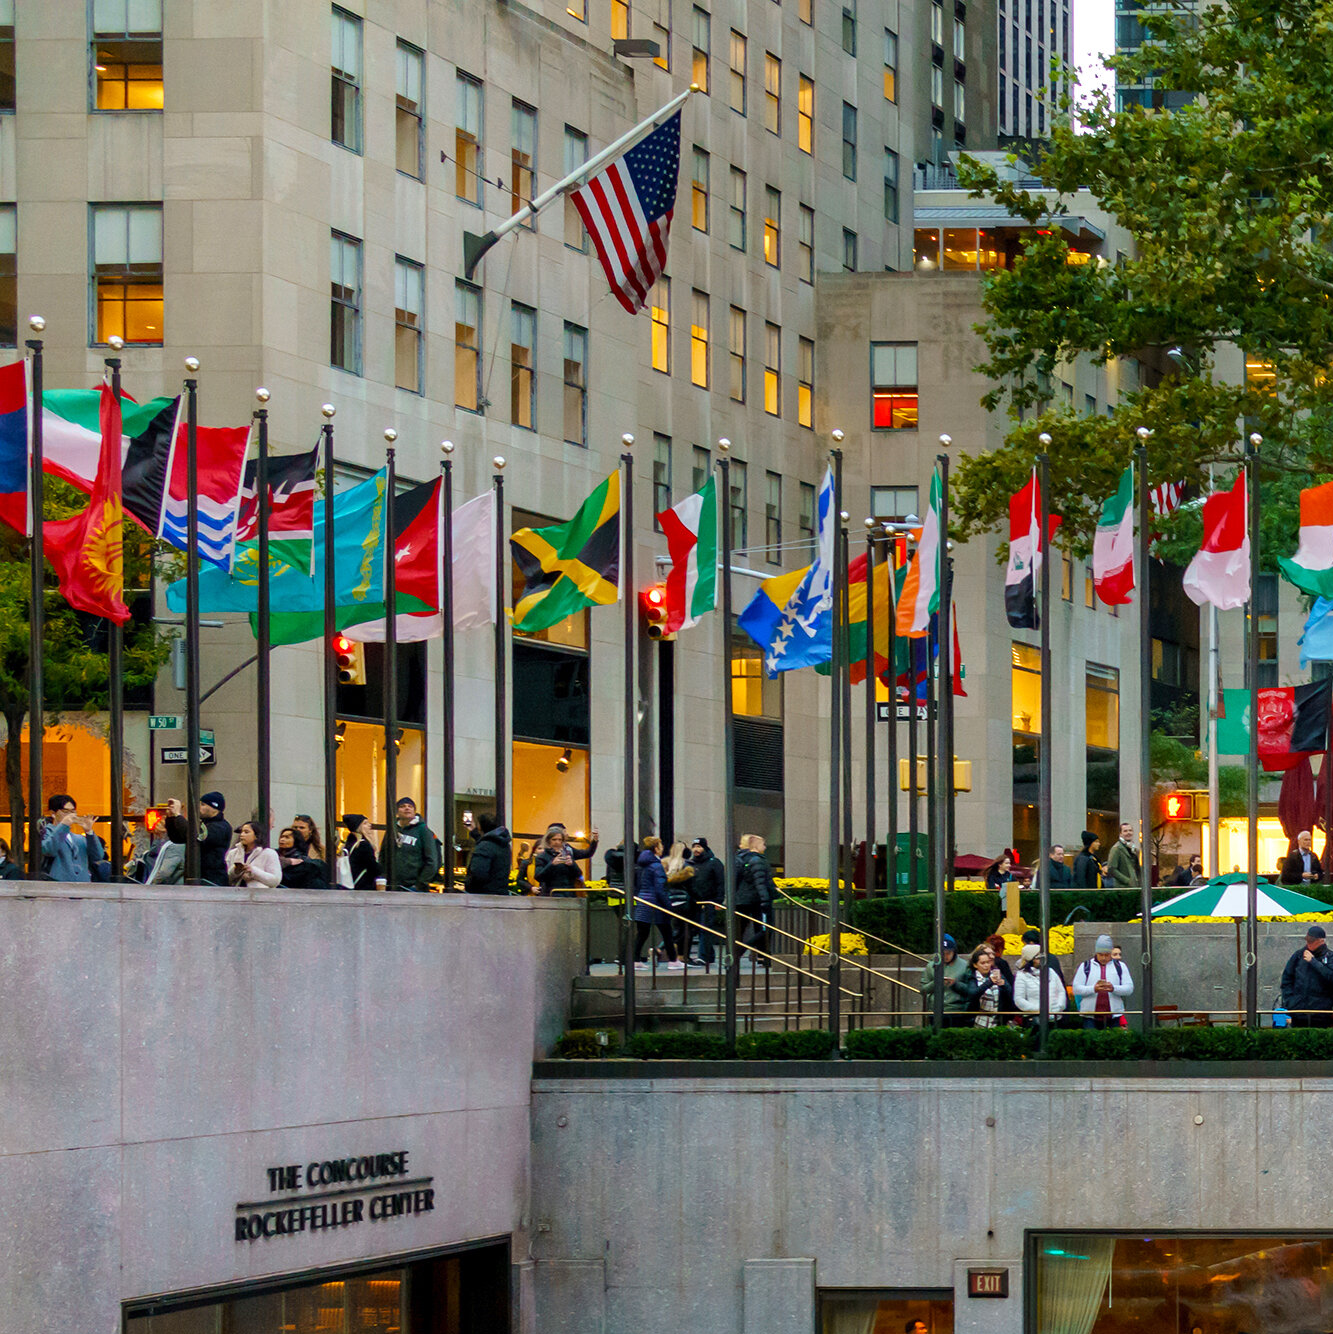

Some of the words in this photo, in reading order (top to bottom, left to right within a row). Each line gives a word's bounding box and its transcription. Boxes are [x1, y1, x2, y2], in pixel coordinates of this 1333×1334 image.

[158, 718, 167, 727] 50
[266, 1164, 303, 1192] THE
[306, 1151, 410, 1187] CONCOURSE
[235, 1199, 364, 1242] ROCKEFELLER
[369, 1188, 436, 1220] CENTER
[977, 1275, 1001, 1291] EXIT
